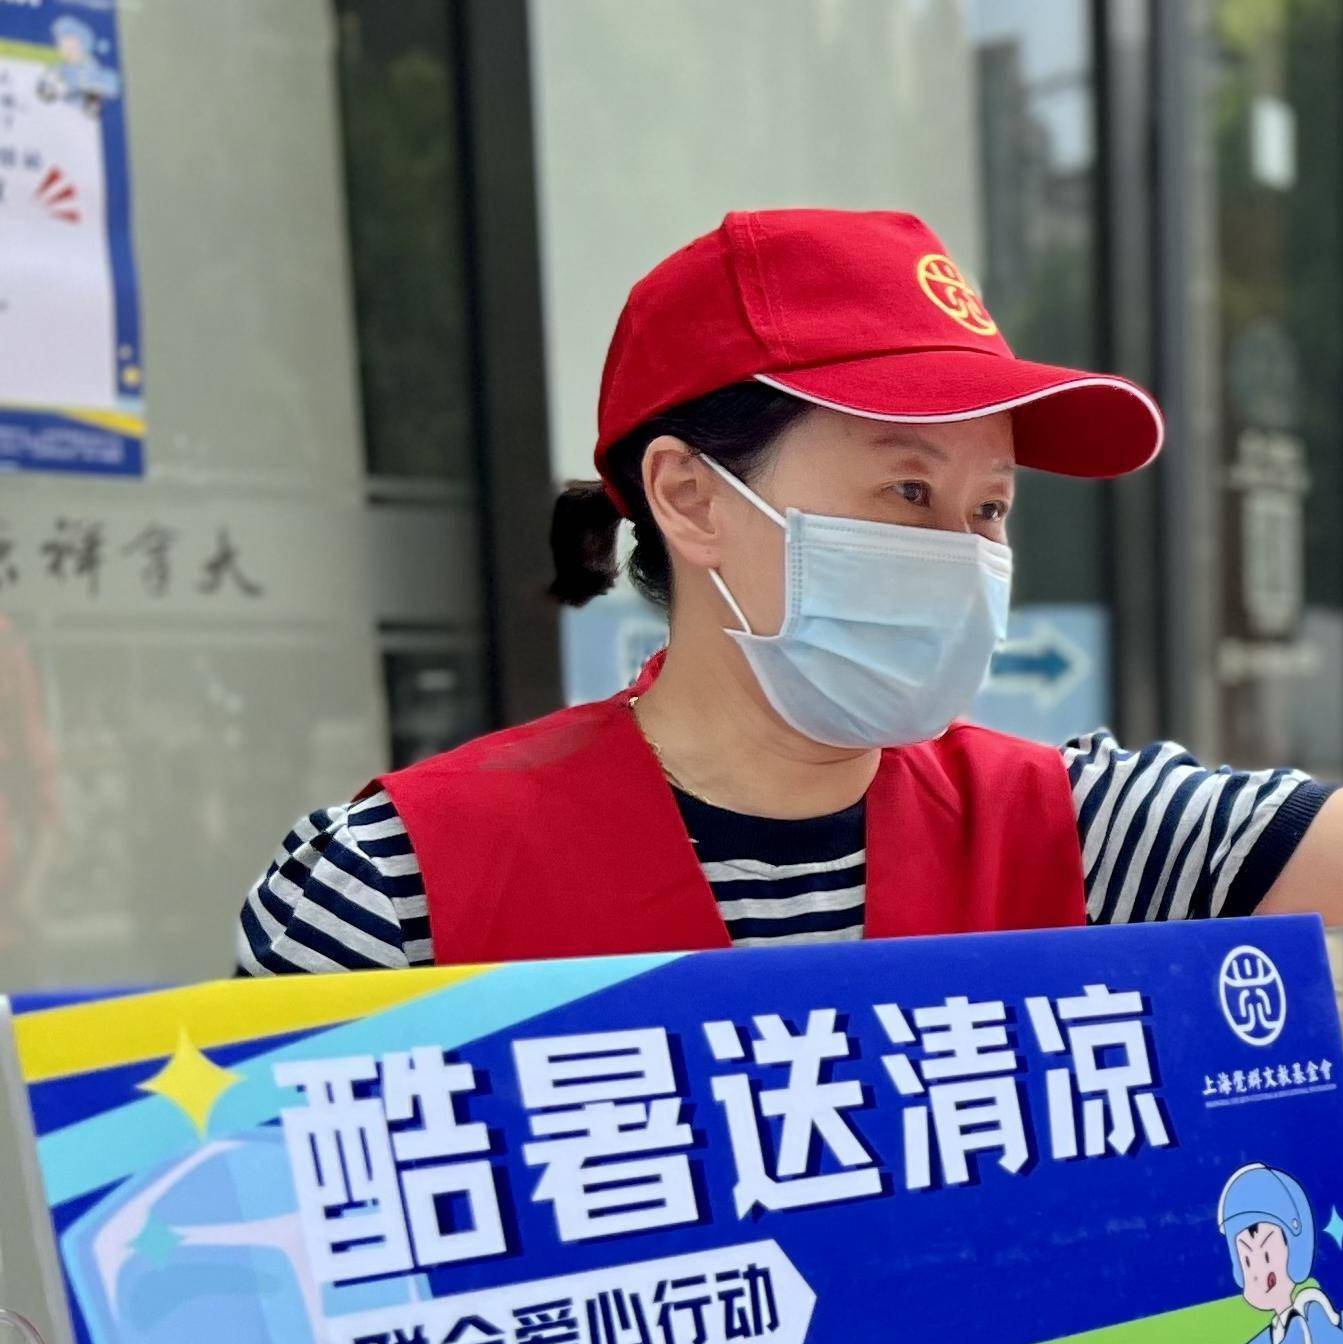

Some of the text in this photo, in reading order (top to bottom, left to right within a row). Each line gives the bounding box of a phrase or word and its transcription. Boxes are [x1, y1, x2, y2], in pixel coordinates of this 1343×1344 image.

[273, 985, 1170, 1284] 酷暑送清凉
